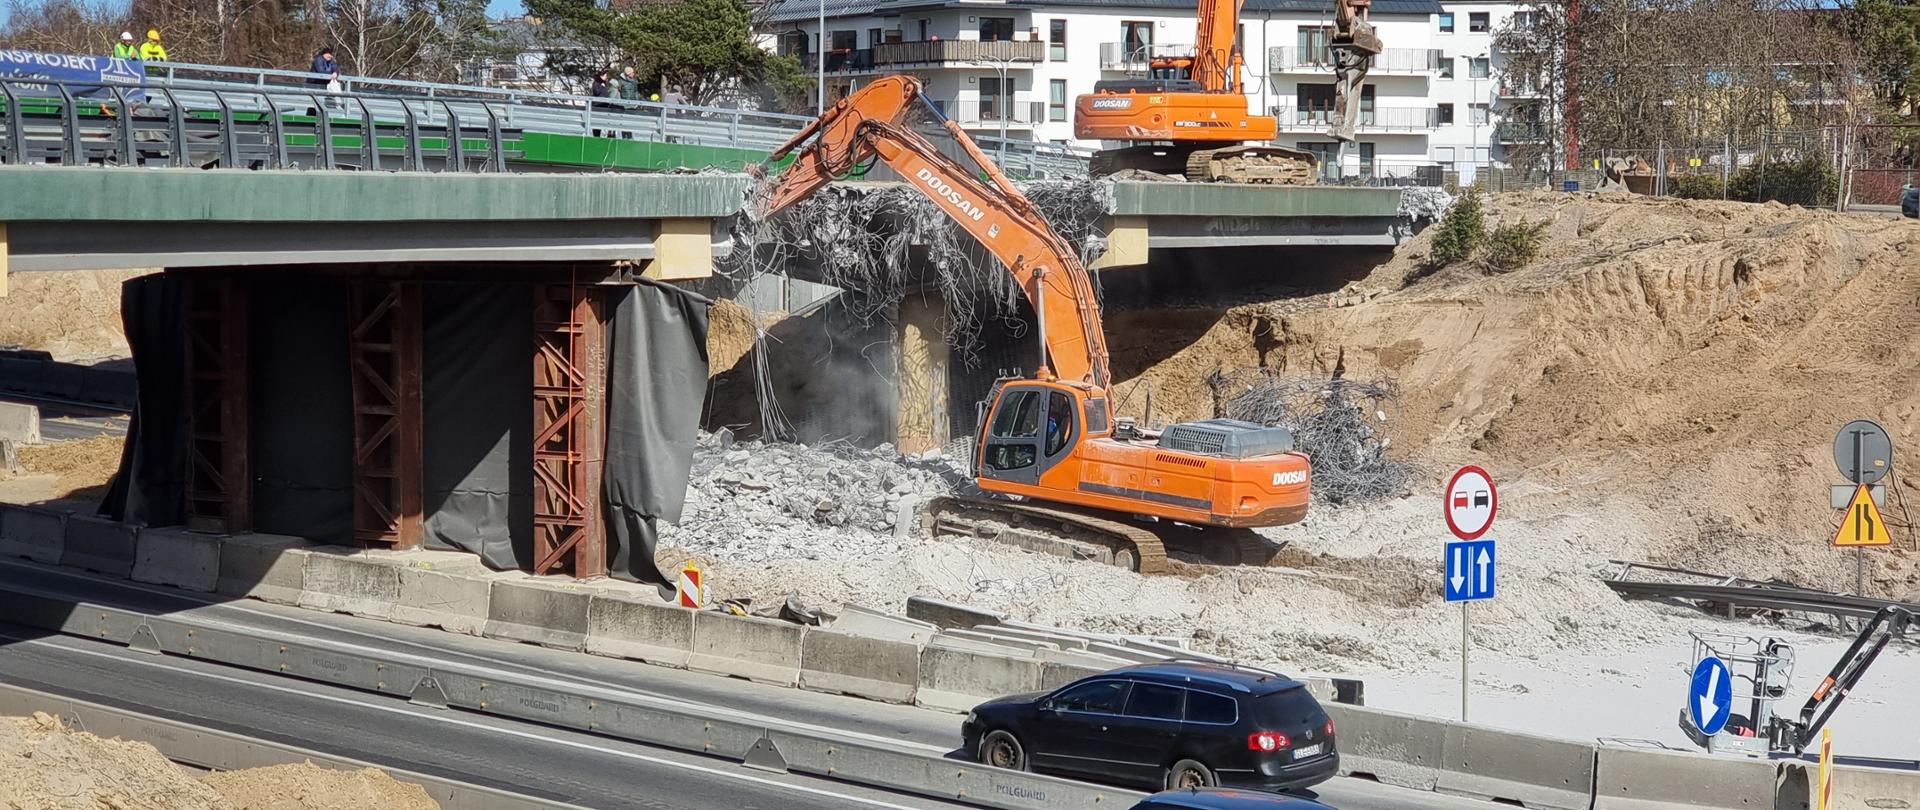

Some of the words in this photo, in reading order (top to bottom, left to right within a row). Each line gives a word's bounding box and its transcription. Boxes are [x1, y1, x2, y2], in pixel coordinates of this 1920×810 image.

[1093, 99, 1130, 109] DOOSAN
[916, 168, 984, 221] DOOSAN
[1272, 470, 1307, 486] DOOSAN
[996, 784, 1046, 800] POLGUARD
